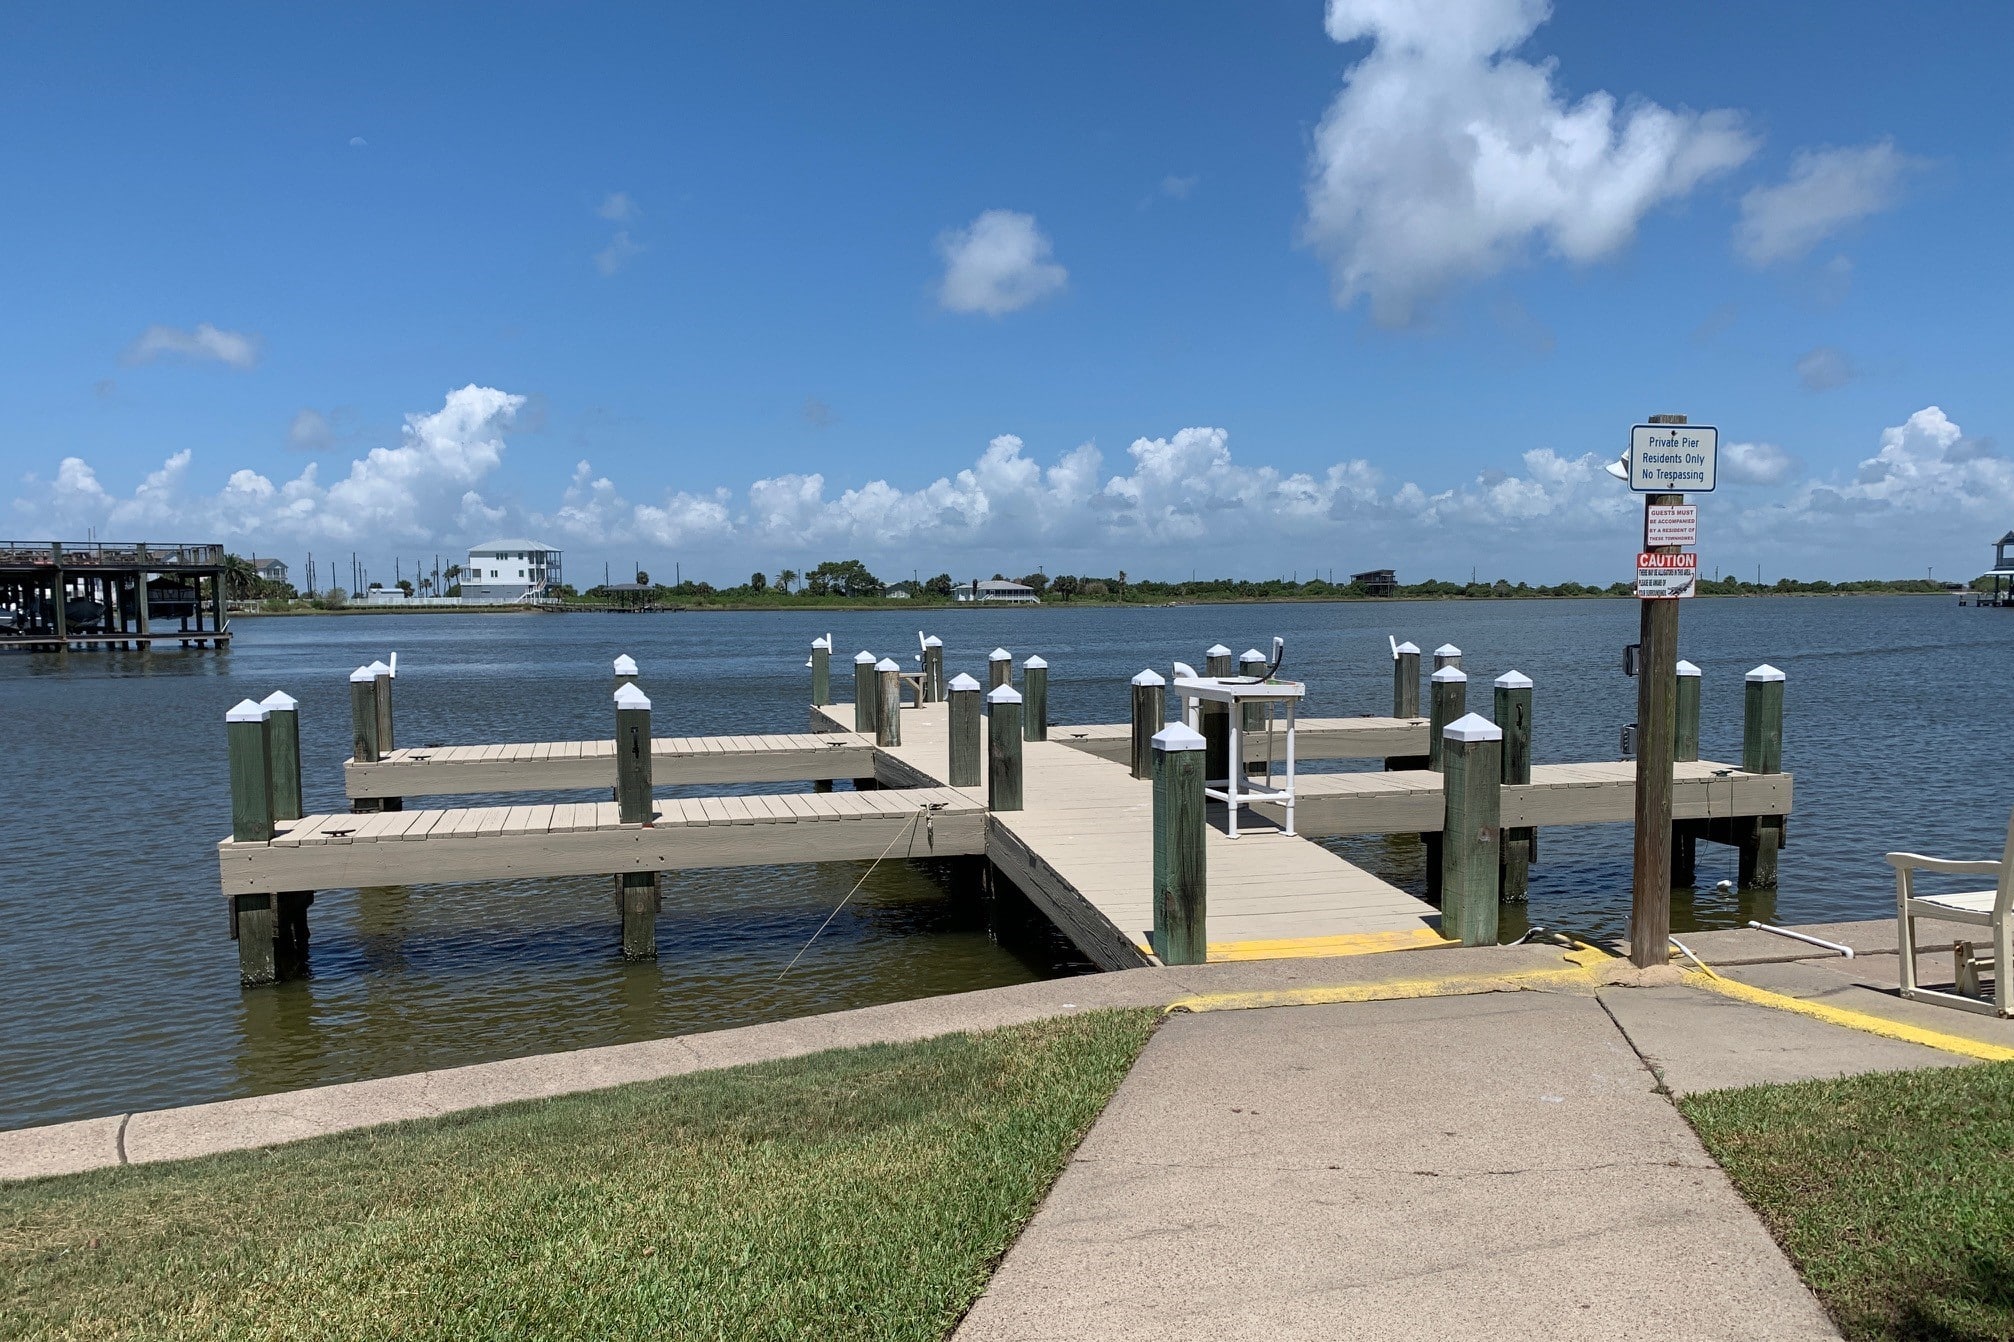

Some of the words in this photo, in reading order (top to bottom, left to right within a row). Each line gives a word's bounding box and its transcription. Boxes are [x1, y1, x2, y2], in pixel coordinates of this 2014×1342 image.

[1650, 436, 1679, 448] Private
[1682, 437, 1700, 448] Pier
[1642, 452, 1682, 464] Residents
[1685, 453, 1705, 466] Only
[1642, 469, 1654, 479] No
[1656, 469, 1704, 482] Trespassing
[1640, 554, 1694, 567] CAUTION
